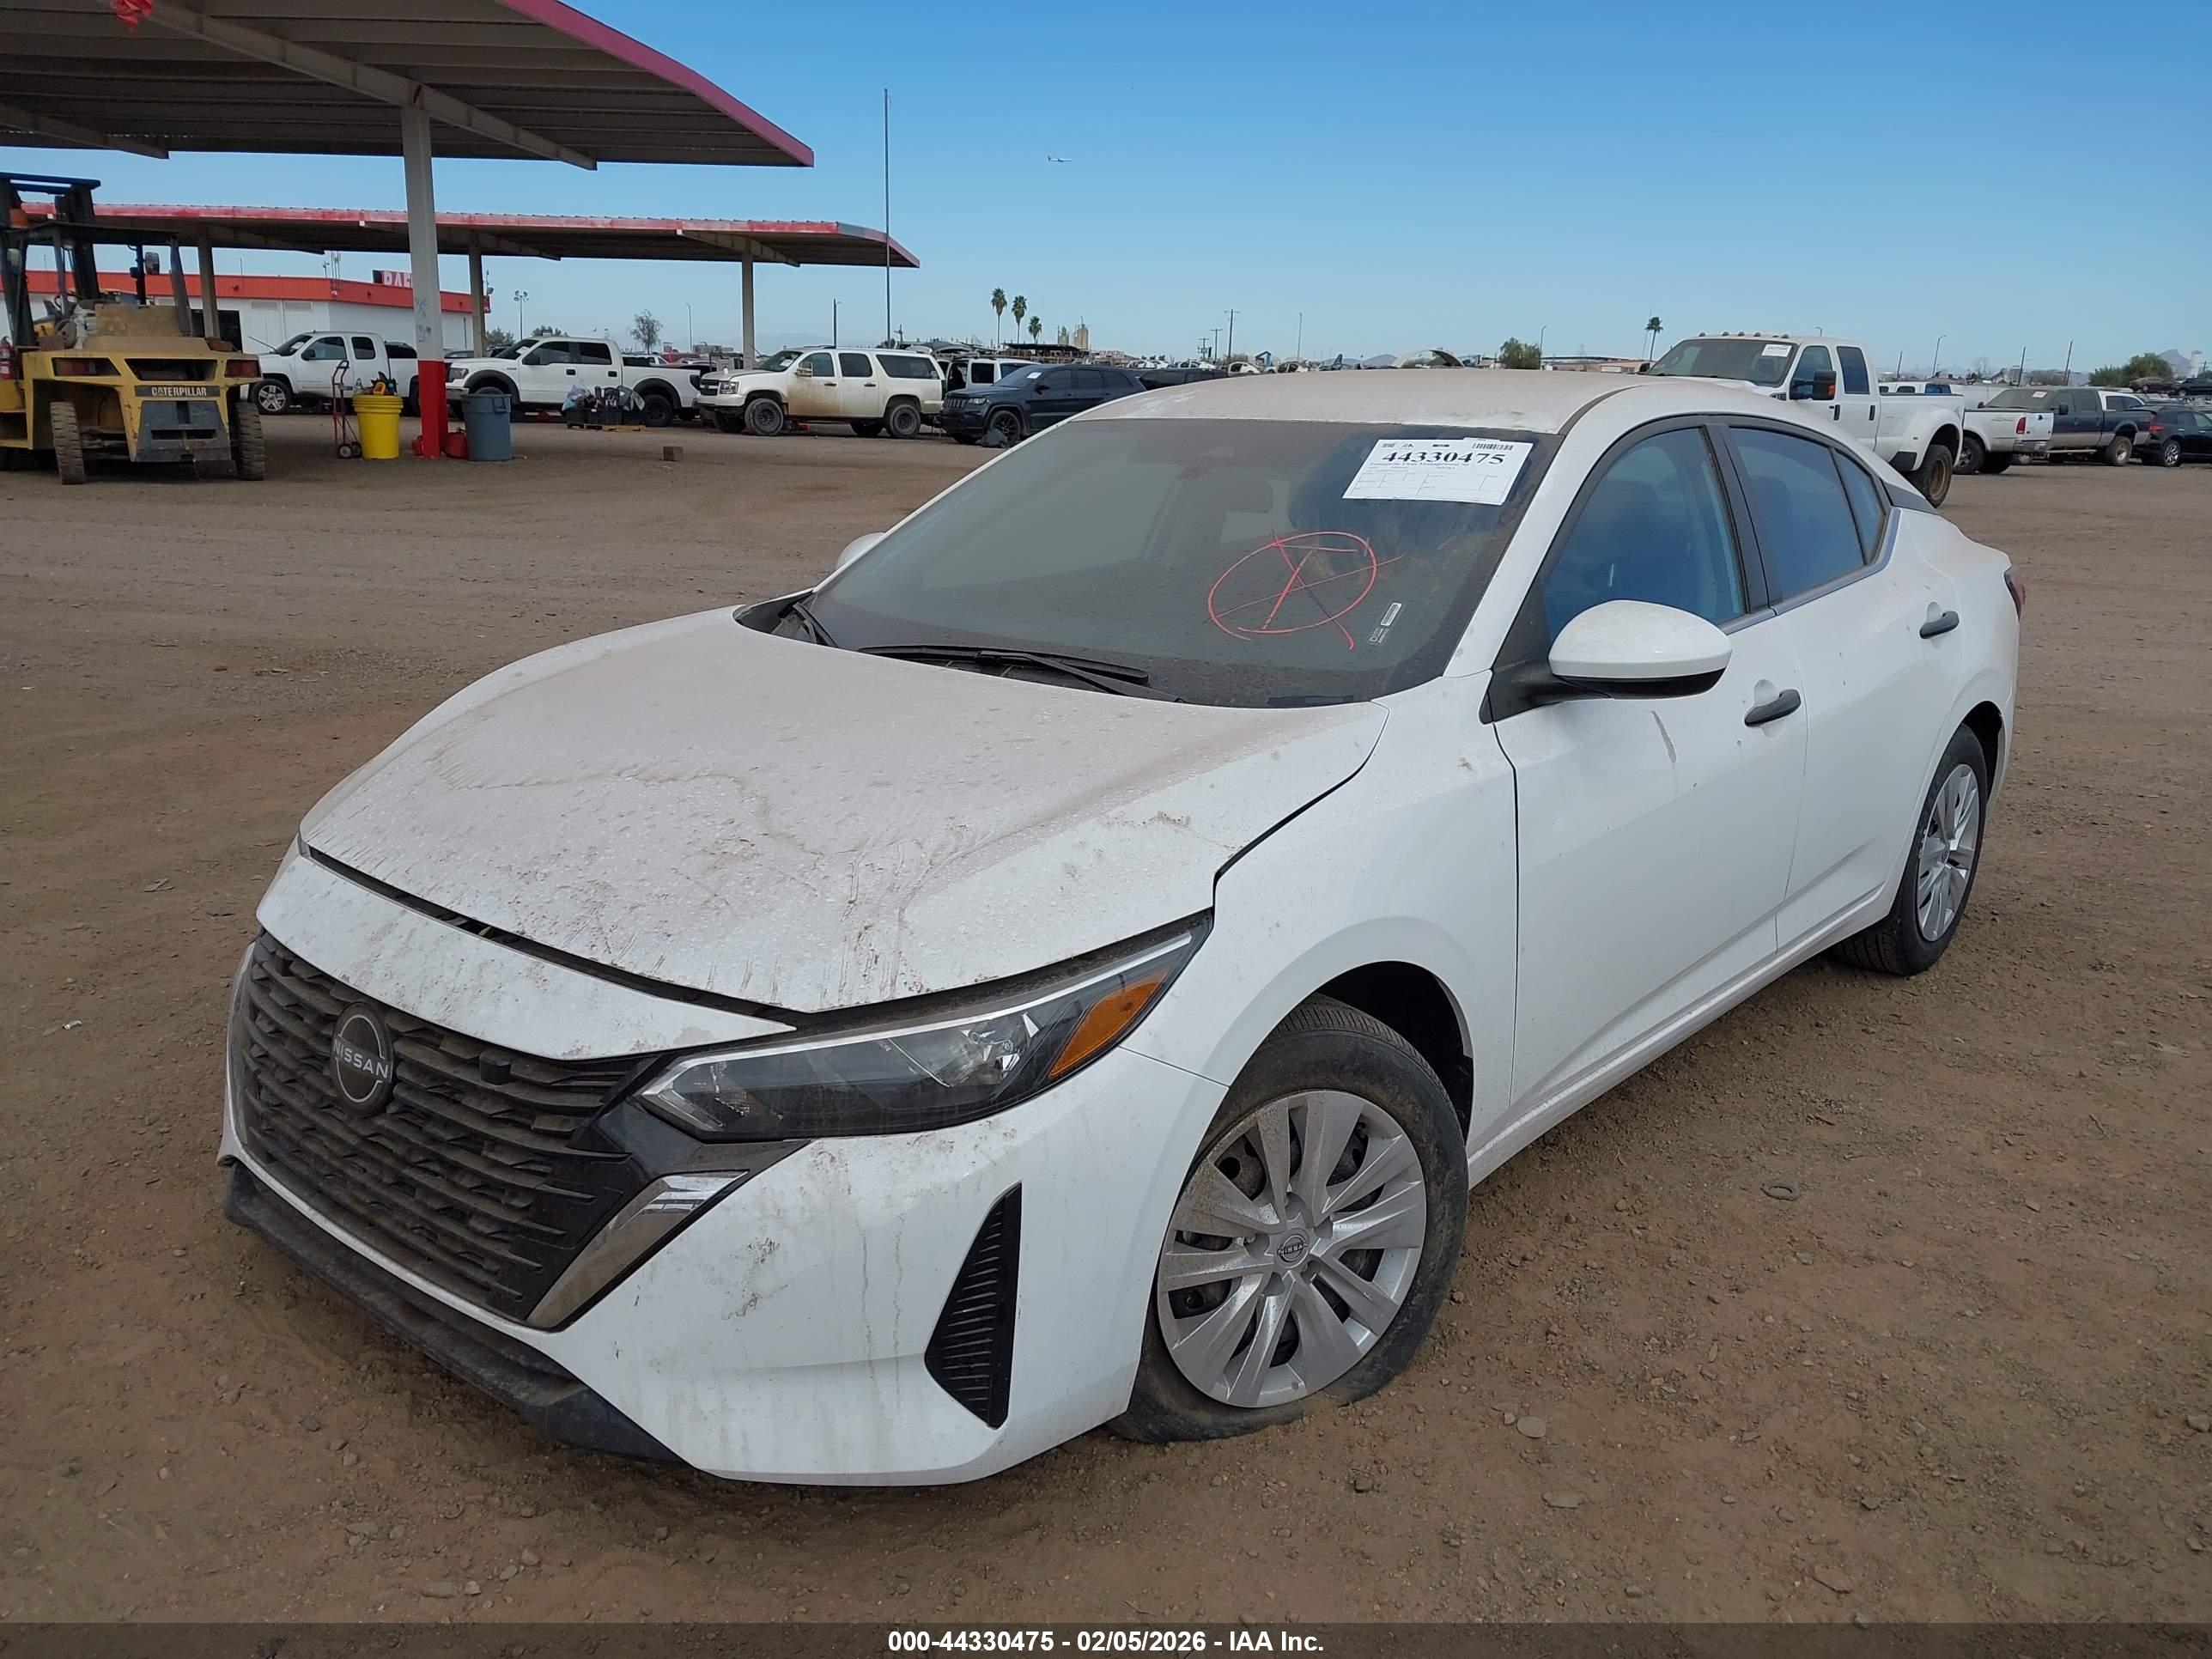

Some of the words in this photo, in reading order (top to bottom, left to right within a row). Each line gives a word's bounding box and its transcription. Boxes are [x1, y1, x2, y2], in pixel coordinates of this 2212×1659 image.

[151, 386, 207, 397] CATERPILLAR
[1382, 452, 1507, 465] 44330475
[332, 1038, 389, 1079] NISSAN
[1278, 1242, 1308, 1255] NISSAN
